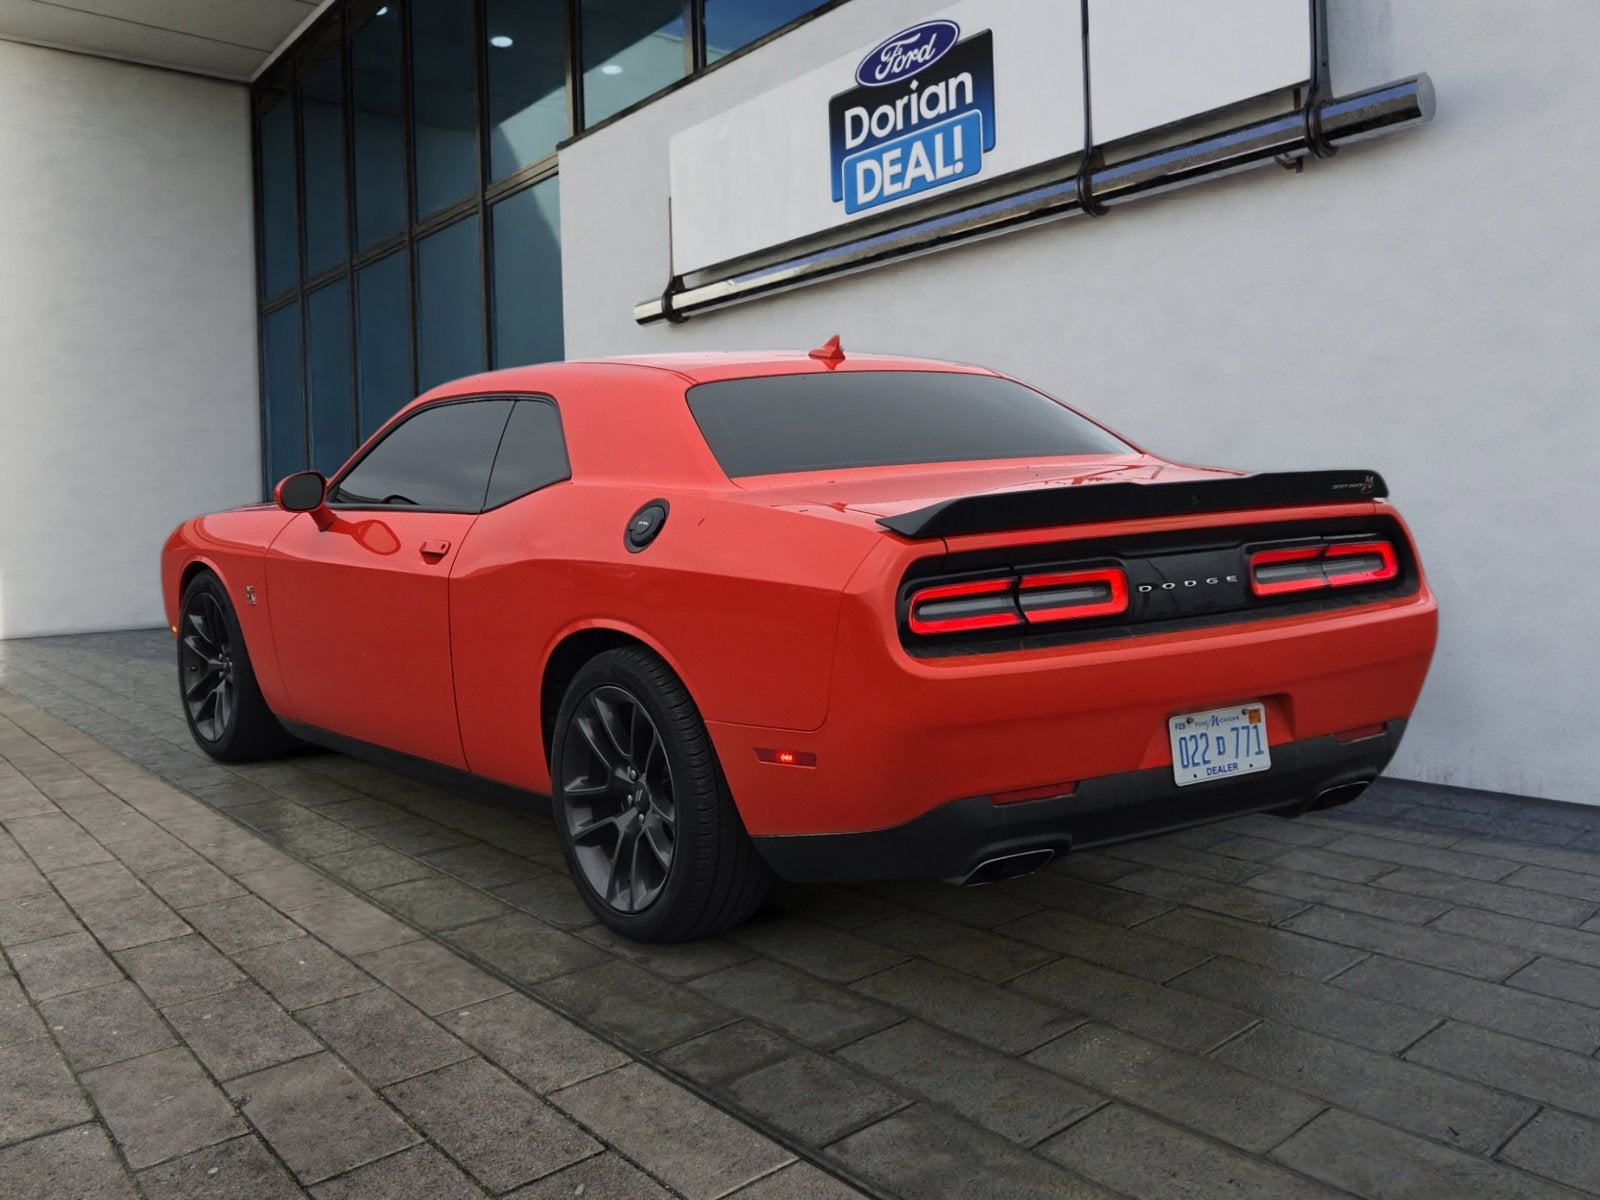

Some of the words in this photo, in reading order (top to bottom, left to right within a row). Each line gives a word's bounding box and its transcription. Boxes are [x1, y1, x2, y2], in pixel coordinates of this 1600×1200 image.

[874, 32, 938, 81] Ford
[844, 71, 974, 150] Dorian
[856, 124, 964, 206] DEAL!
[1138, 575, 1238, 592] DODGE
[1174, 722, 1186, 730] FEB
[1178, 732, 1211, 770] 022
[1215, 736, 1226, 756] D
[1230, 724, 1265, 759] 771
[1206, 762, 1239, 776] DEALER
